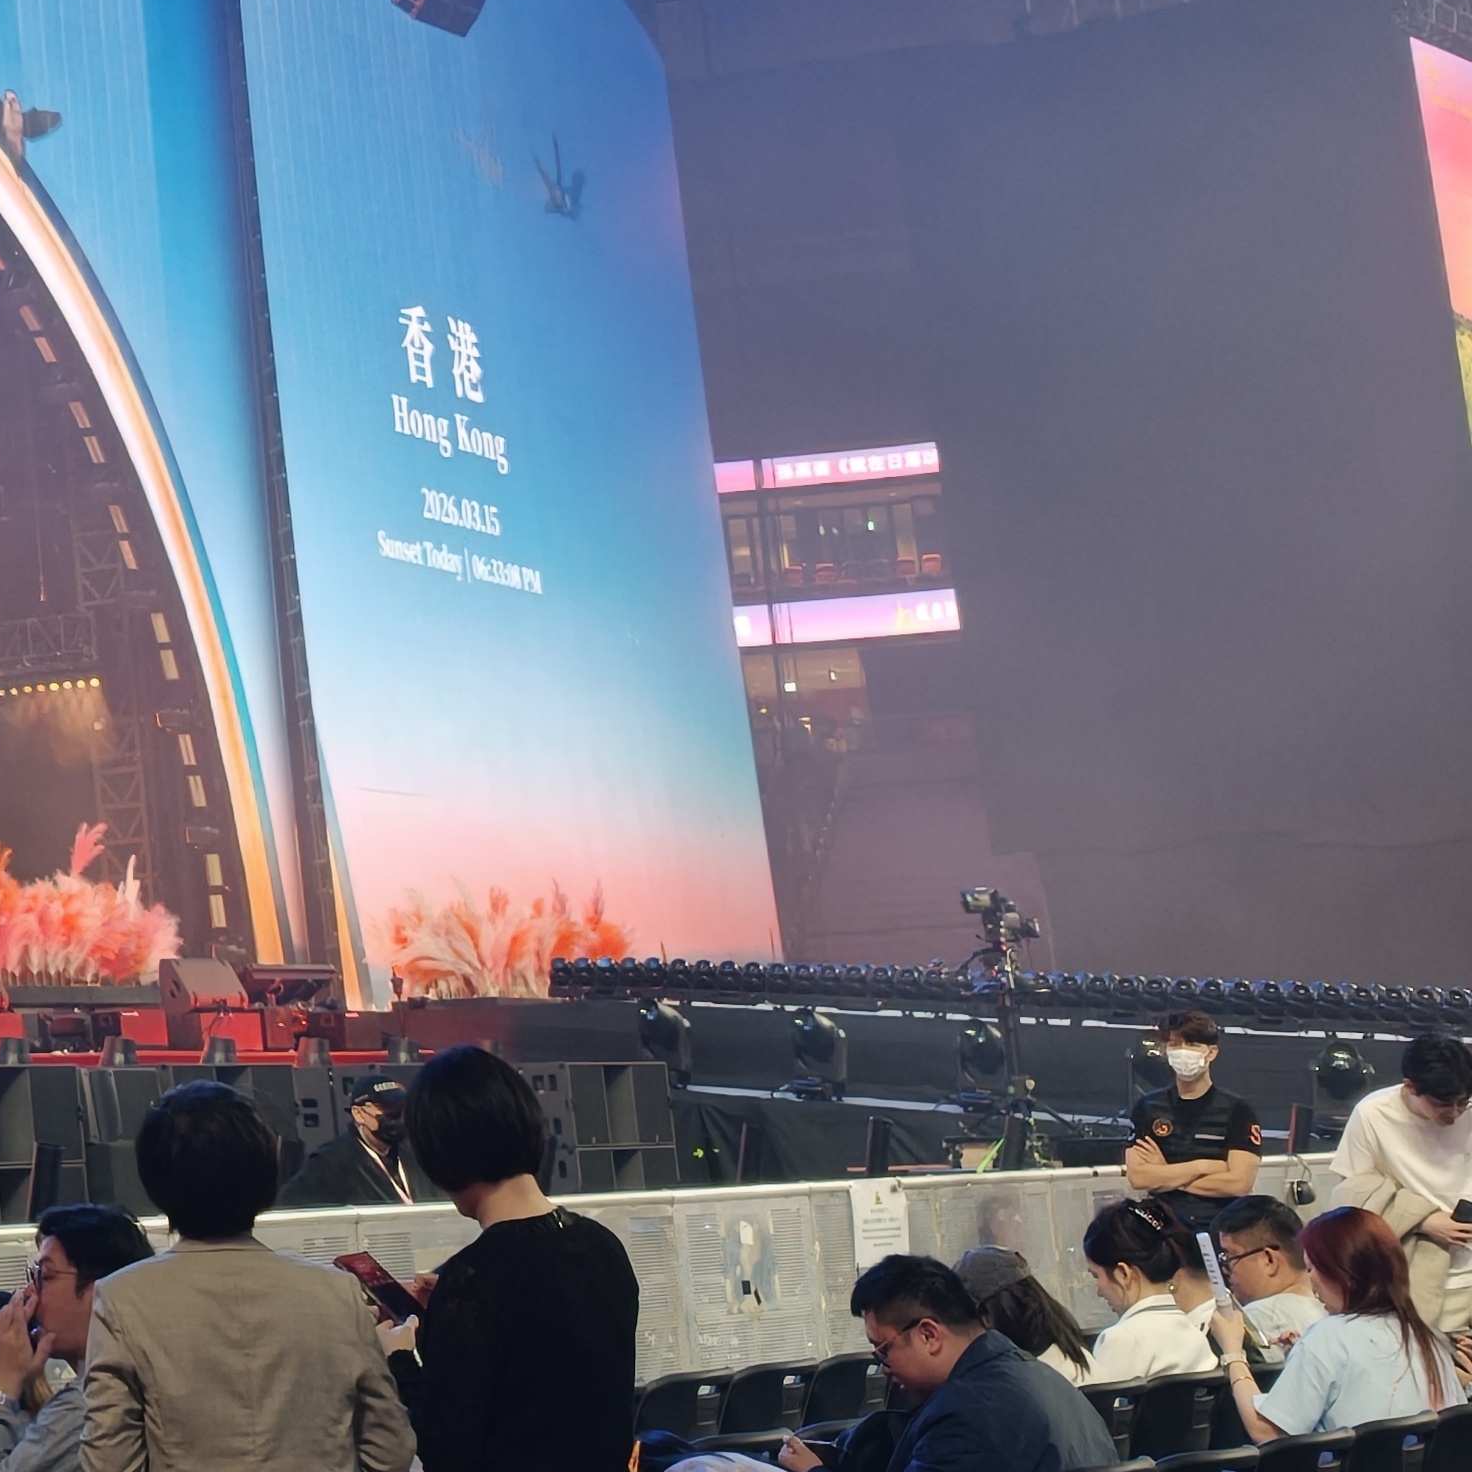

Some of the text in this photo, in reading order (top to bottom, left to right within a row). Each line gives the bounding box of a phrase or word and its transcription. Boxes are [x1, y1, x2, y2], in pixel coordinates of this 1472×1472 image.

[398, 305, 485, 404] 香港
[391, 393, 510, 475] Hong Kong
[421, 487, 501, 536] 2026.03.15
[377, 530, 423, 565] Sunset
[423, 541, 462, 582] Today
[471, 554, 522, 590] 06:33:08
[521, 566, 543, 595] PM
